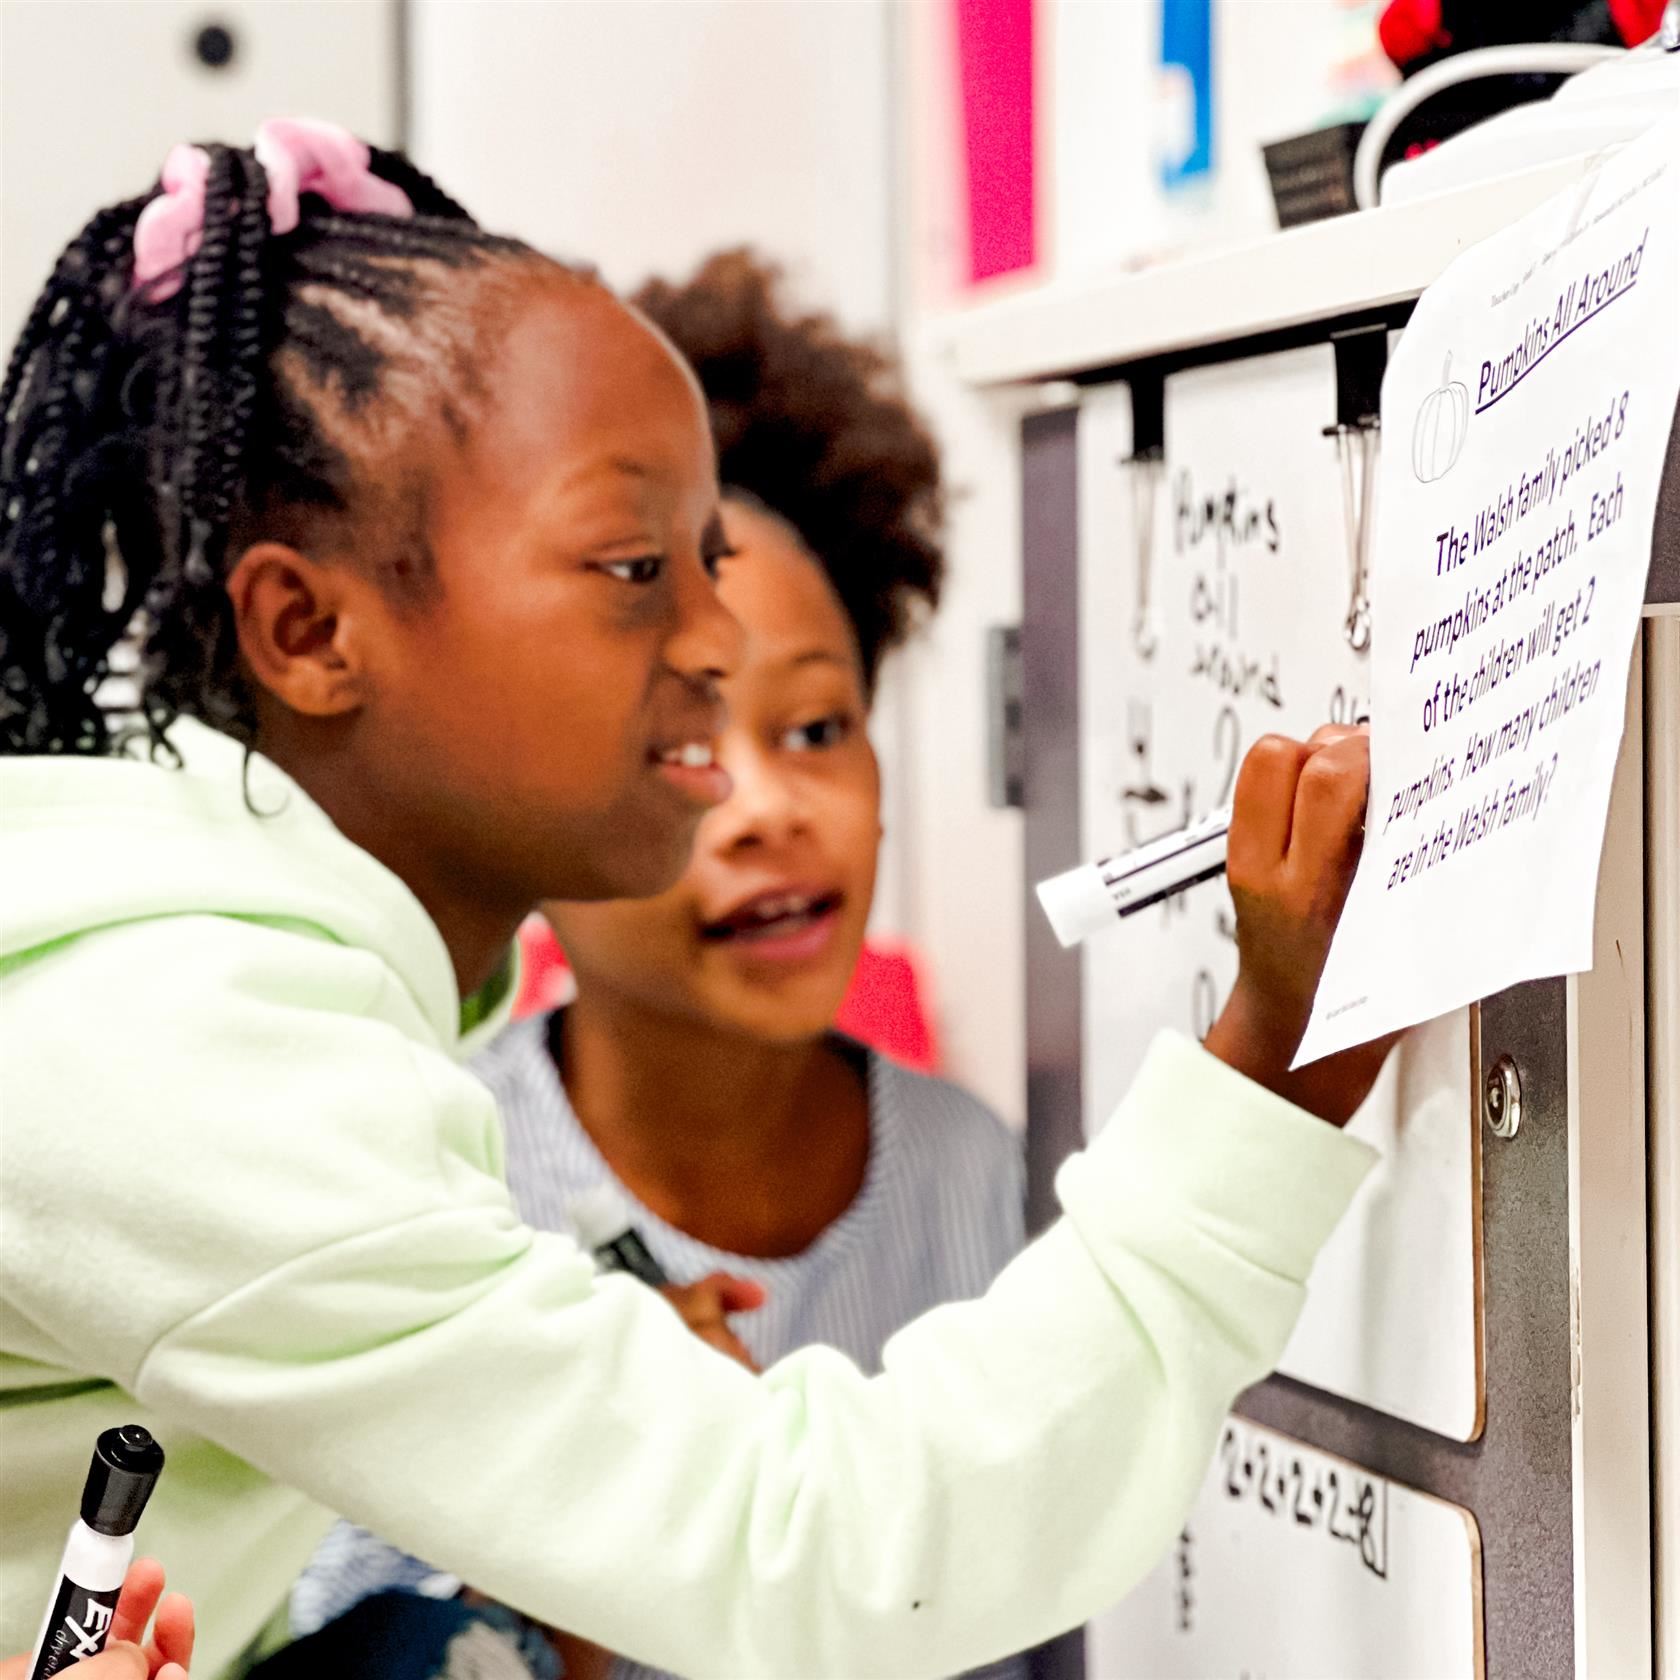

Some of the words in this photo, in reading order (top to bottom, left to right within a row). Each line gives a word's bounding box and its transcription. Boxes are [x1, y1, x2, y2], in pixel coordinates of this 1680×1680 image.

[1478, 316, 1550, 404] Pumpkins
[1551, 281, 1576, 341] All
[1574, 226, 1649, 321] Around
[1436, 526, 1469, 576] The
[1473, 485, 1514, 555] Walsh
[1516, 448, 1560, 505] family
[1560, 398, 1615, 496] picked
[1614, 390, 1629, 440] 8
[1410, 587, 1490, 674] pumpkins
[1492, 569, 1507, 615] at
[1509, 550, 1531, 602] the
[1531, 509, 1577, 594] patch.
[1588, 471, 1623, 541] Each
[1423, 680, 1441, 732] of
[1444, 673, 1467, 721] the
[1469, 638, 1524, 705] children
[1526, 601, 1555, 664] will
[1552, 588, 1581, 656] get
[1582, 576, 1596, 624] 2
[1383, 754, 1454, 836] pumpkins.
[1461, 730, 1497, 780] How
[1495, 702, 1539, 751] many
[1539, 659, 1601, 731] children
[1387, 851, 1413, 890] are
[1411, 833, 1428, 878] in
[1427, 820, 1453, 868] the
[1453, 788, 1499, 853] Walsh
[1498, 752, 1559, 829] family?
[64, 1598, 114, 1660] EX
